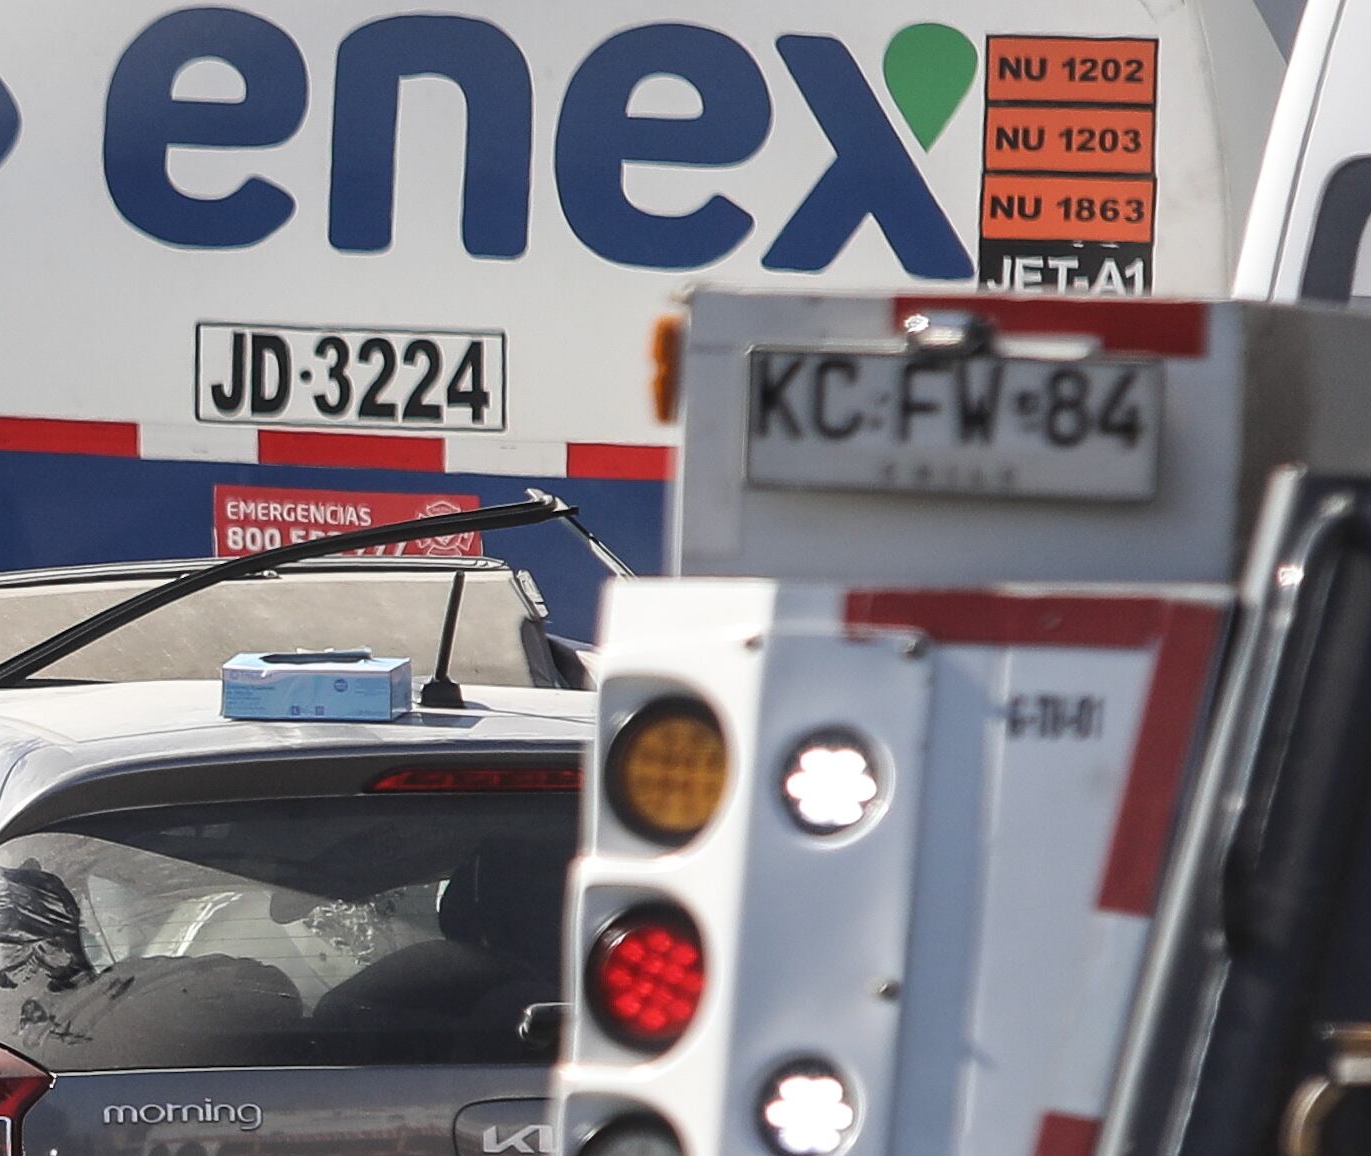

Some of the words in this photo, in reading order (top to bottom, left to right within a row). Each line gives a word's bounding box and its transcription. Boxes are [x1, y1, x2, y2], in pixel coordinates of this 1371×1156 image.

[998, 57, 1047, 81] NU
[1062, 57, 1144, 82] 1202
[103, 7, 976, 278] enex
[995, 126, 1045, 151] NU
[1059, 126, 1141, 153] 1203
[990, 195, 1042, 220] NU
[1057, 197, 1144, 223] 1863
[987, 255, 1146, 296] JET-A1
[226, 500, 372, 527] EMERGENCIAS
[227, 527, 282, 551] 800
[103, 1097, 263, 1131] morning
[482, 1124, 554, 1153] KI
